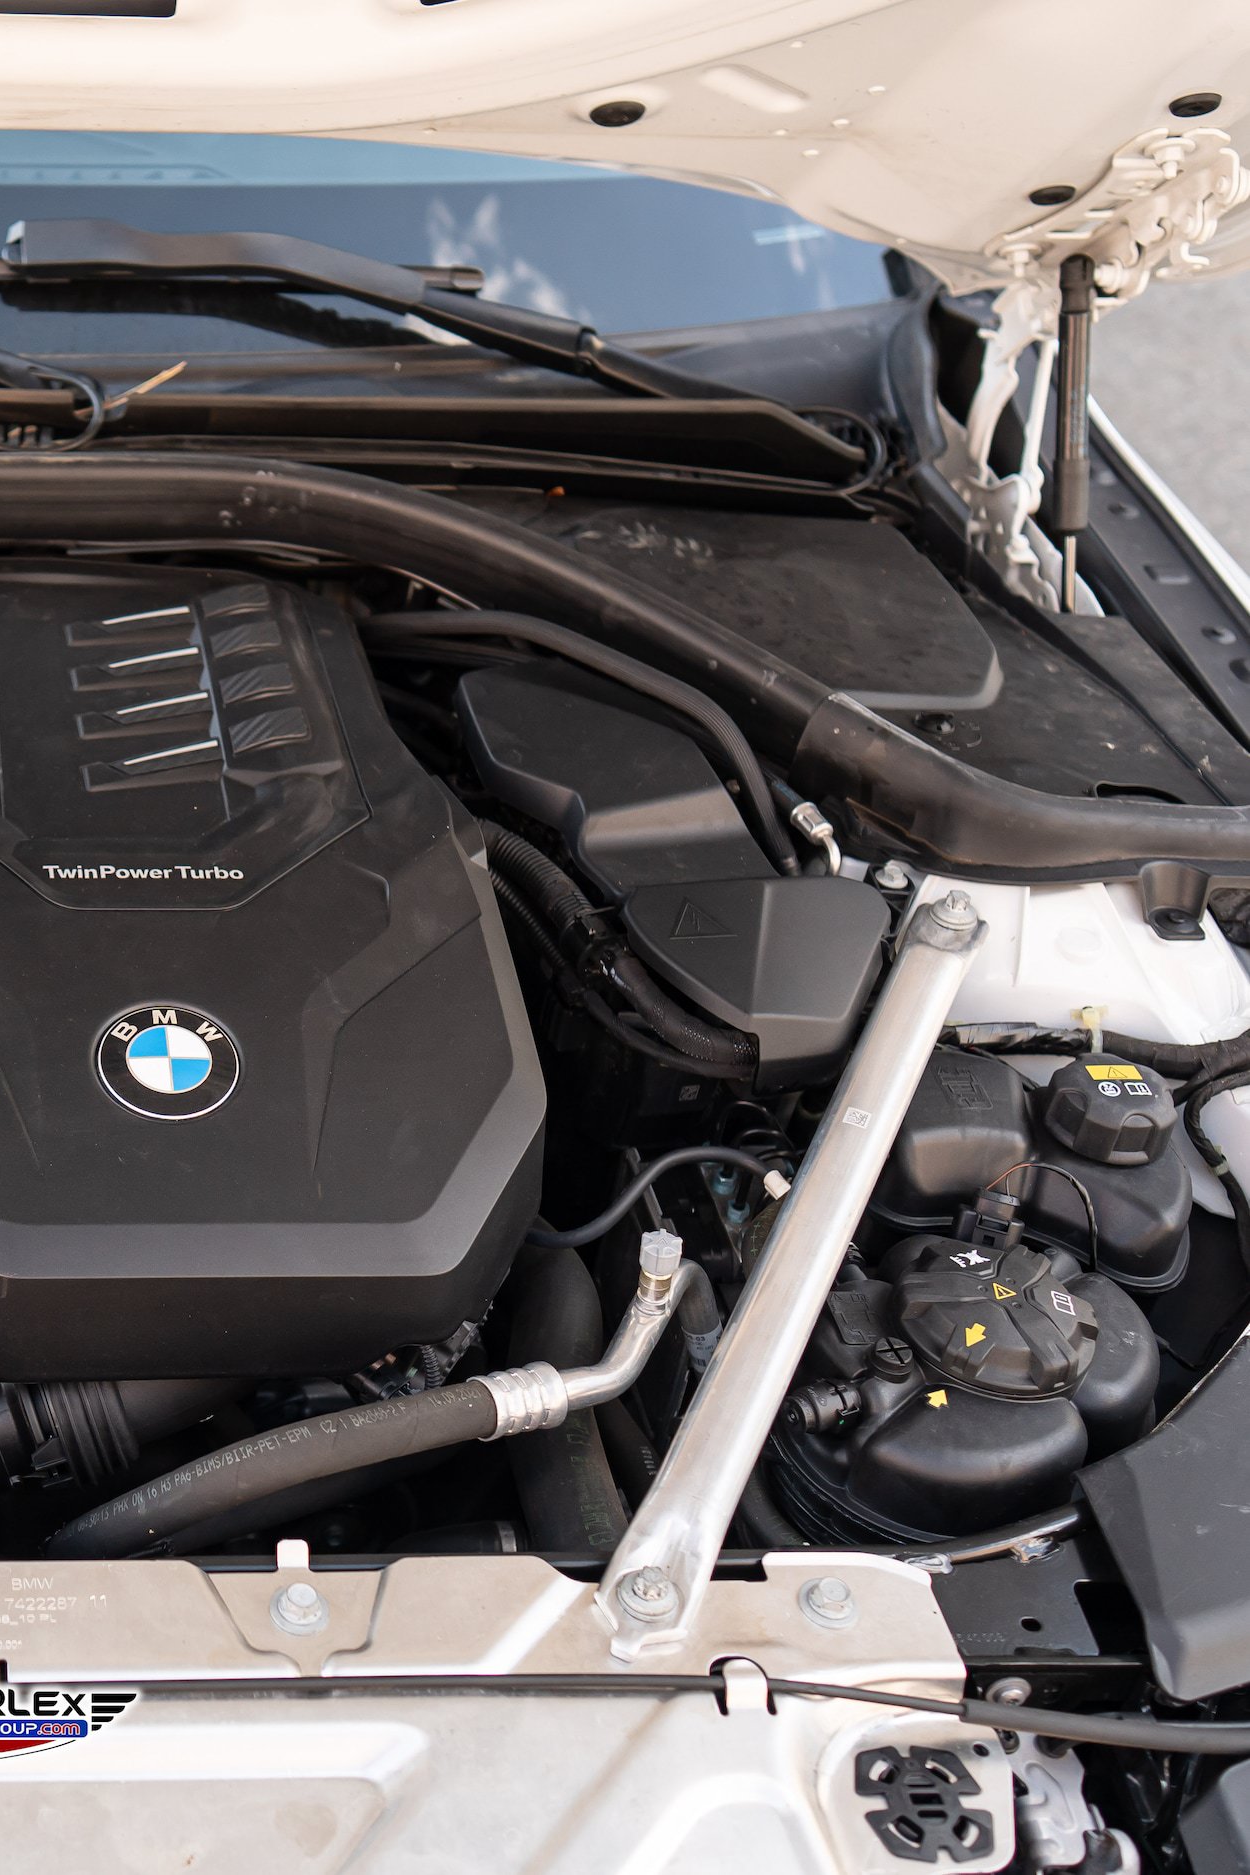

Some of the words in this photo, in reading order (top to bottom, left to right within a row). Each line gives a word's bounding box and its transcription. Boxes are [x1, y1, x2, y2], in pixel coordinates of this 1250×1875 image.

[42, 865, 173, 879] TwinPower
[174, 865, 244, 879] Turbo
[110, 1009, 224, 1042] BMW
[11, 1577, 54, 1590] BMW
[4, 1596, 77, 1611] 7422287
[89, 1594, 107, 1608] 11
